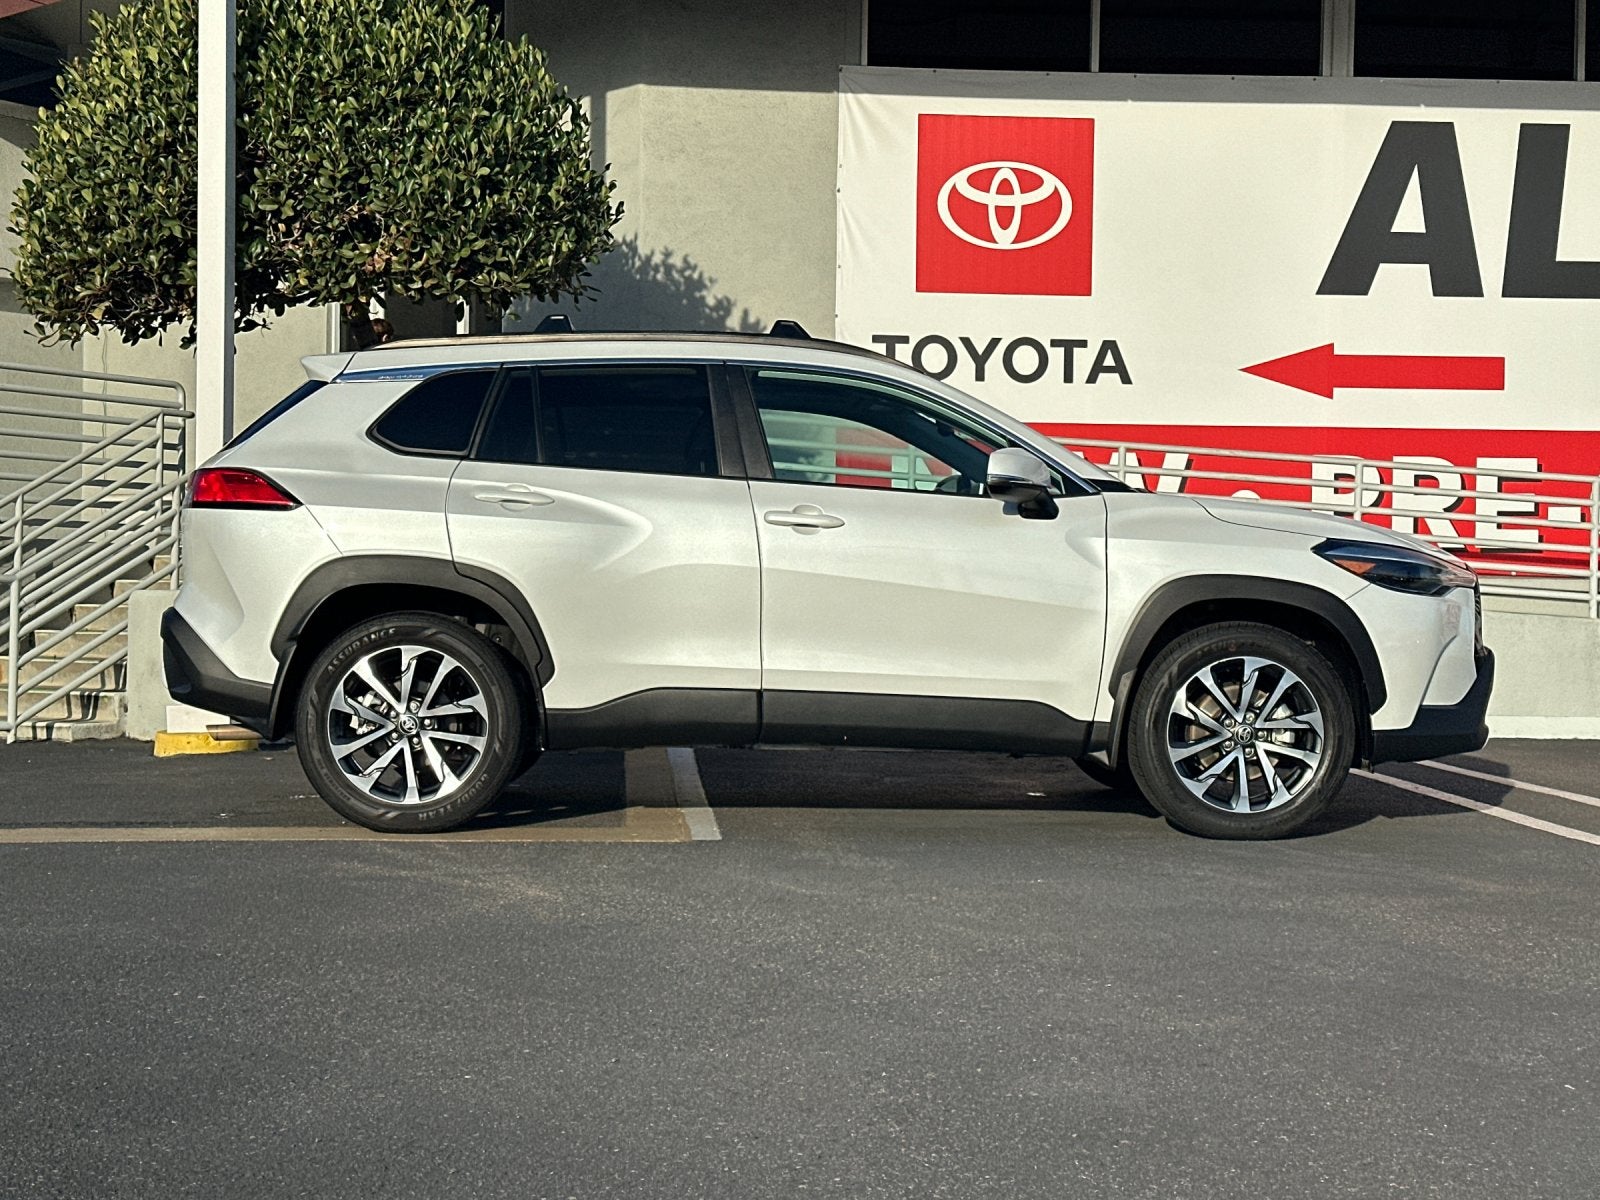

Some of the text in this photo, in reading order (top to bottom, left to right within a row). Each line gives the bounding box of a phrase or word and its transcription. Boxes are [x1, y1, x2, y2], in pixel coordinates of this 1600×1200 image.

[1314, 121, 1600, 299] AL
[871, 334, 1133, 385] TOYOTA
[327, 627, 396, 674] ASSURANCE
